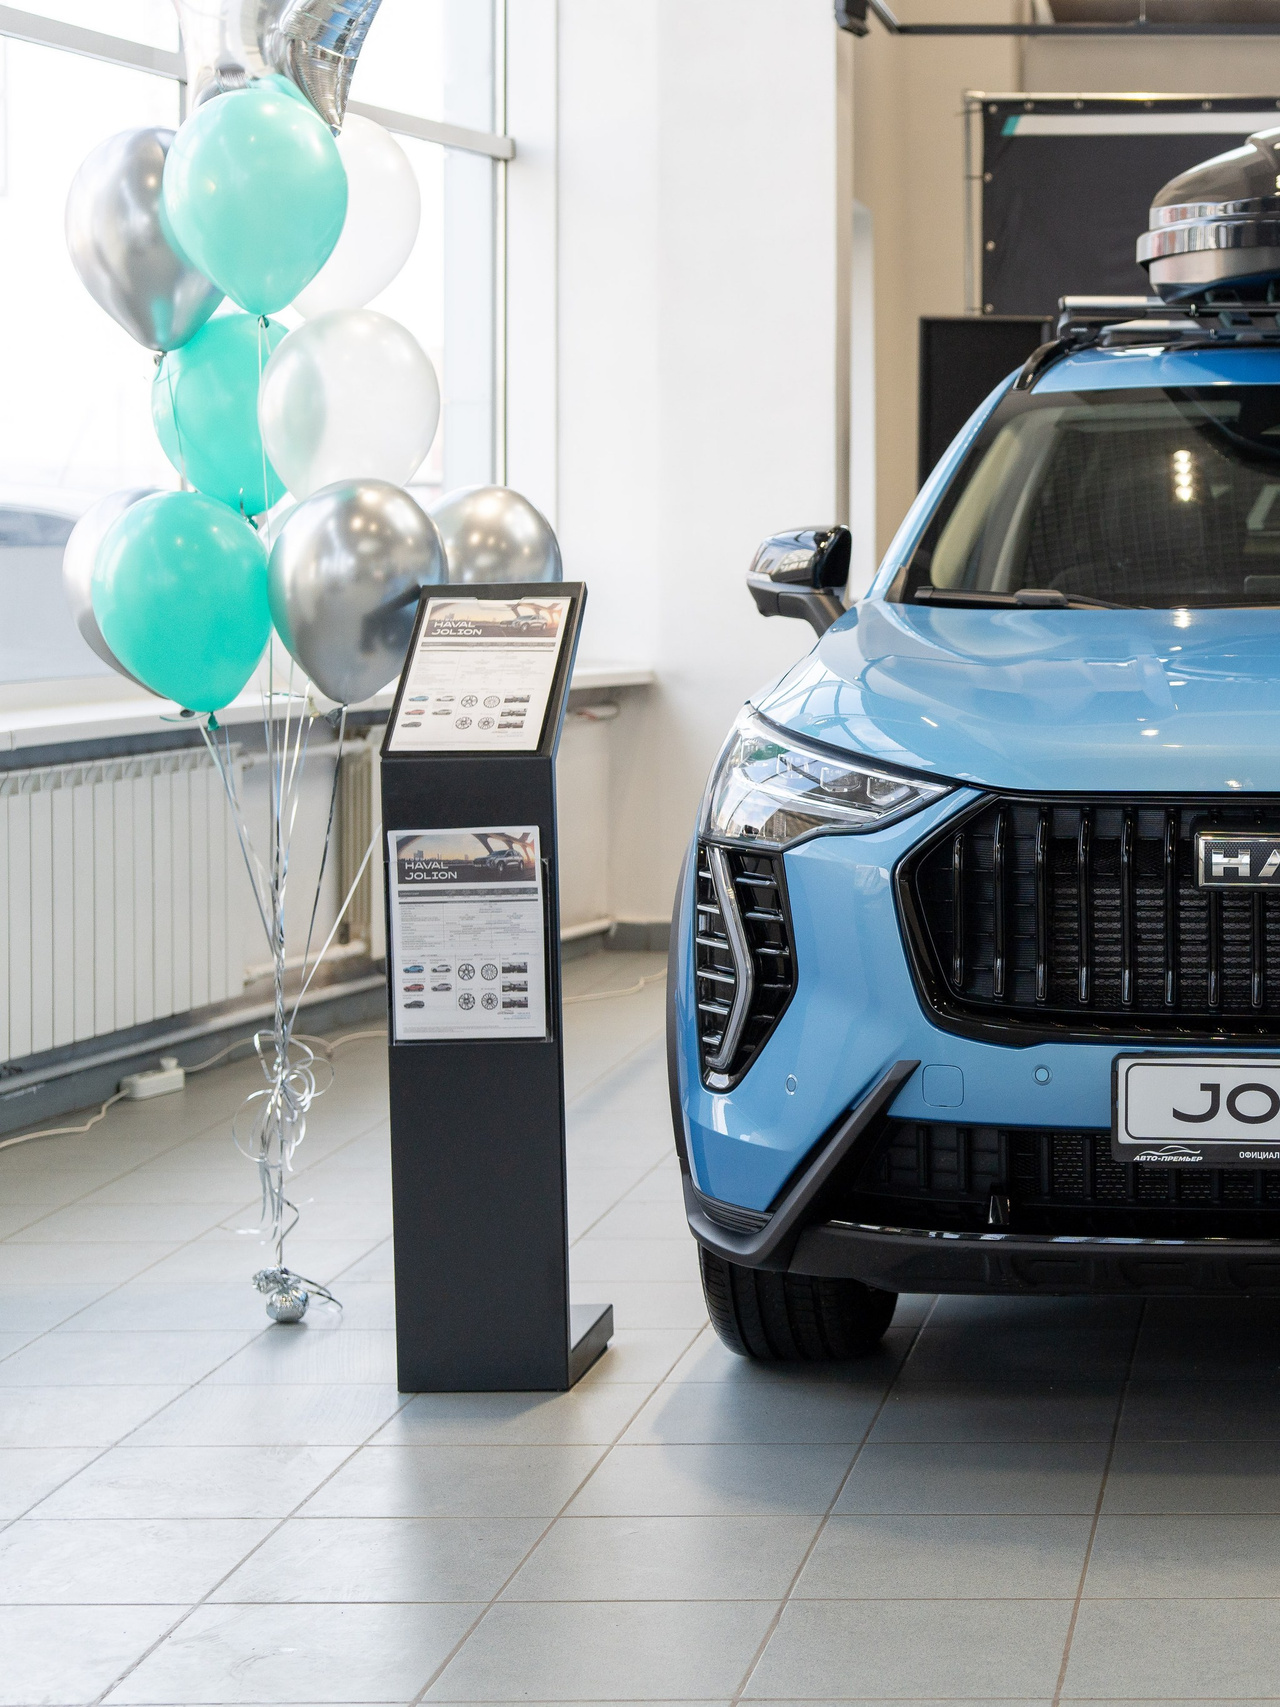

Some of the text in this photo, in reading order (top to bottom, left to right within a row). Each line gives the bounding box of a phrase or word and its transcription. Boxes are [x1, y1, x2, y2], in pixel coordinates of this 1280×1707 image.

[431, 628, 482, 636] JOLION
[405, 861, 449, 870] HAVAL
[404, 871, 458, 880] JOLION
[1133, 1154, 1203, 1162] АВТО-ПРЕМЬЕР
